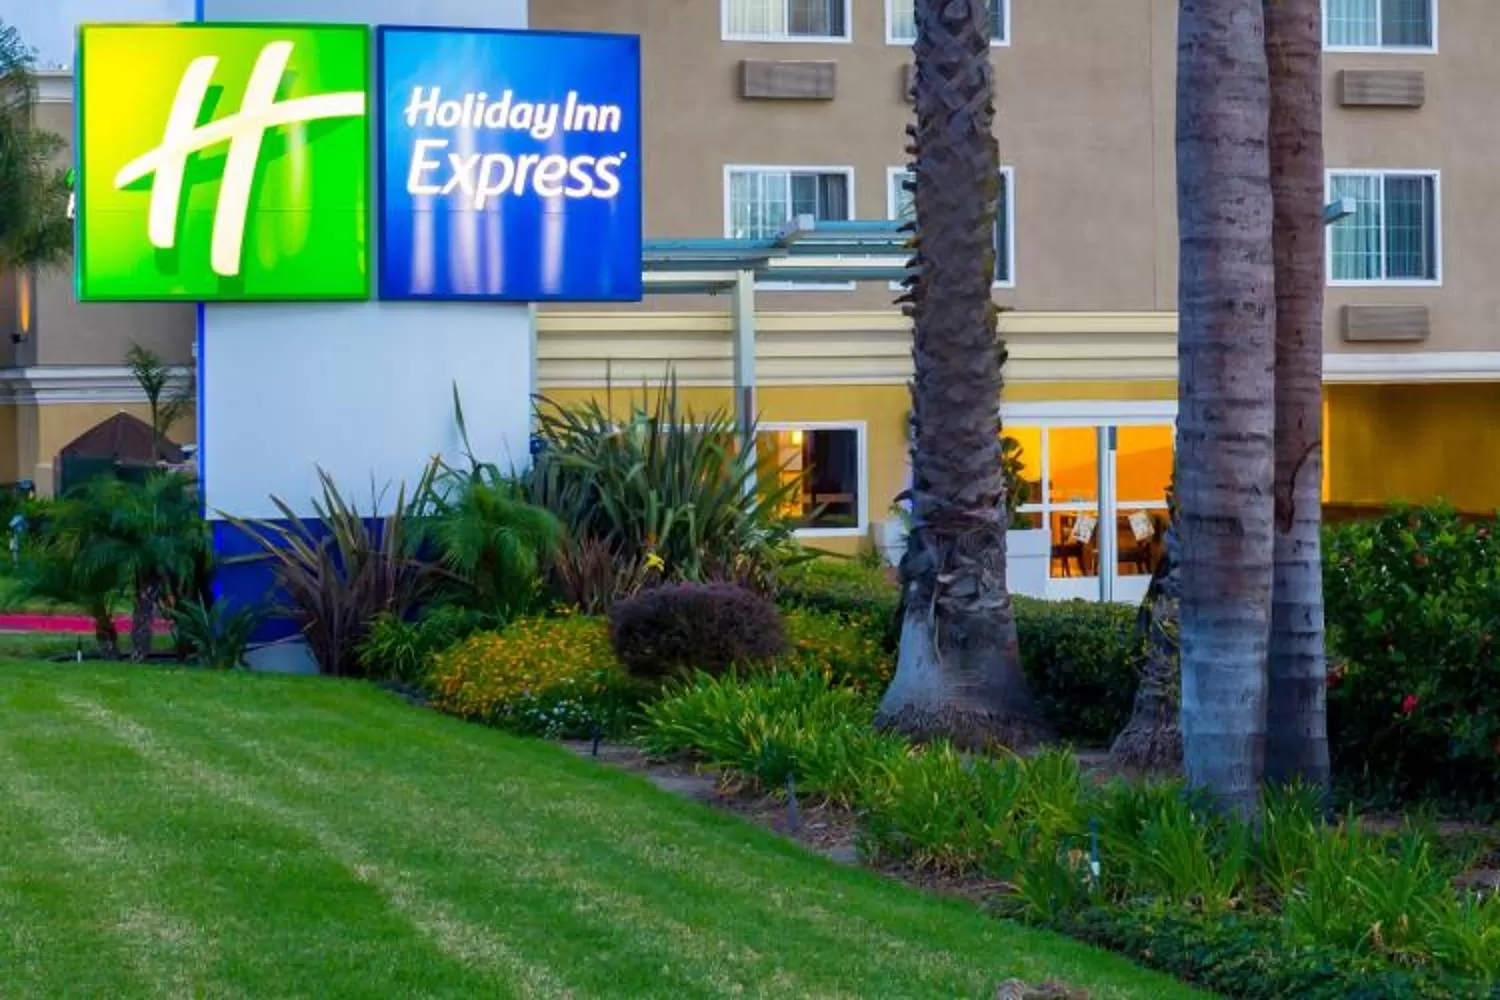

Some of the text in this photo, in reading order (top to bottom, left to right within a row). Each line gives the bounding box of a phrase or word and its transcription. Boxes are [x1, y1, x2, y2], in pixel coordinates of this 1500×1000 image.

[404, 86, 621, 139] Holiday Inn
[114, 40, 365, 276] H
[406, 138, 623, 211] Express
